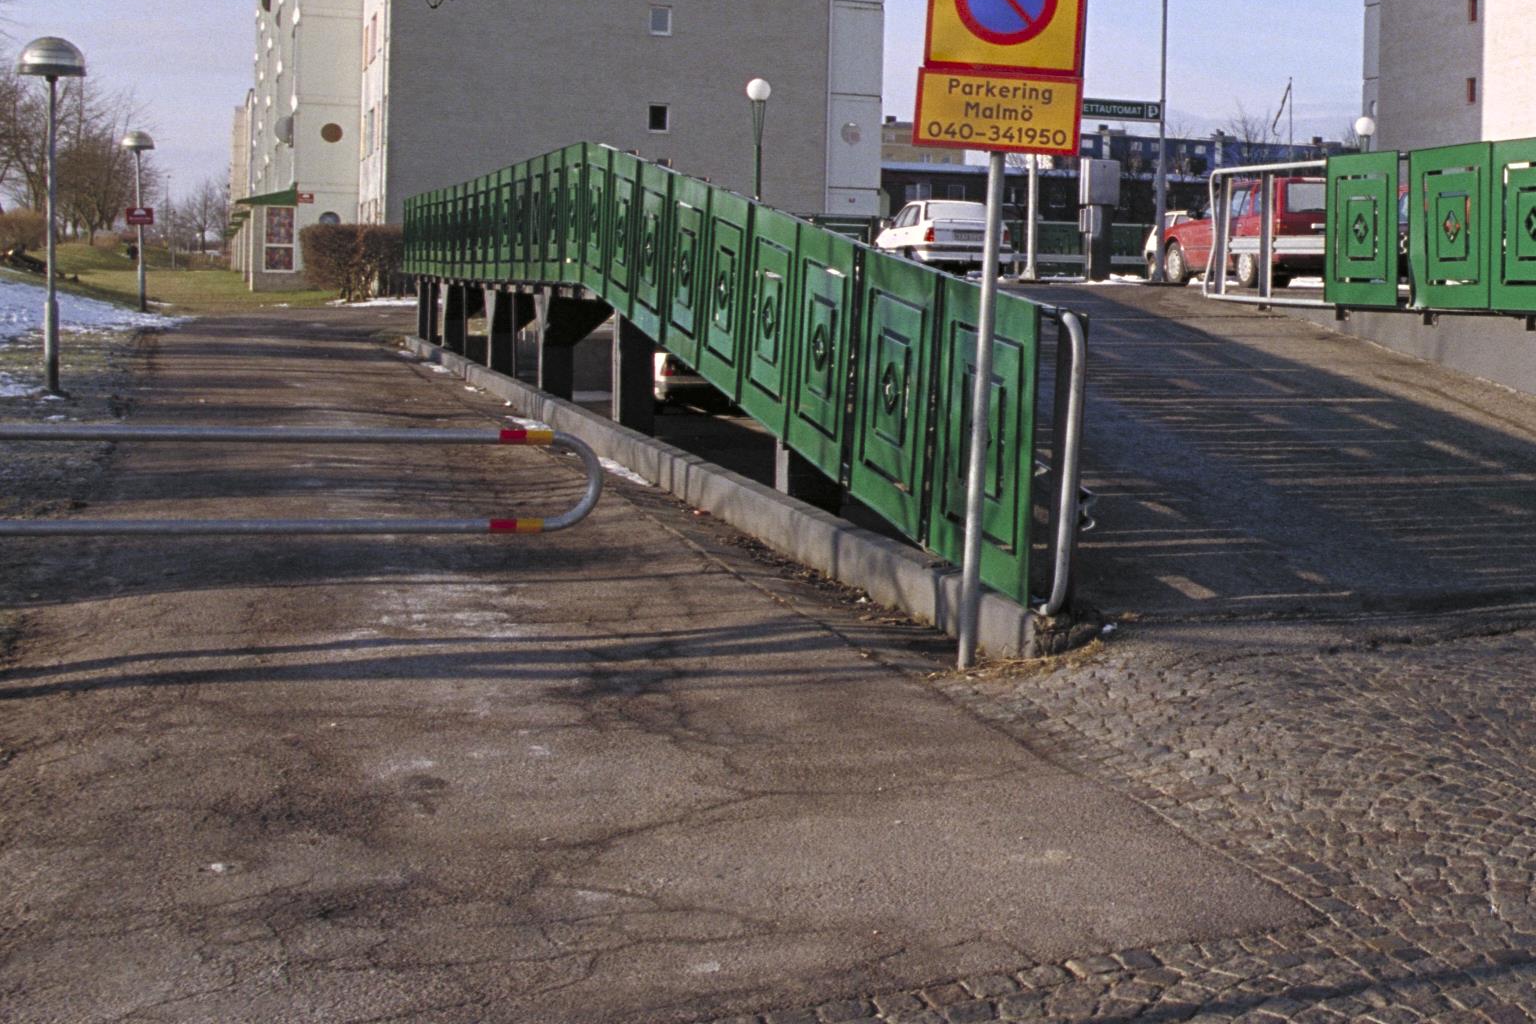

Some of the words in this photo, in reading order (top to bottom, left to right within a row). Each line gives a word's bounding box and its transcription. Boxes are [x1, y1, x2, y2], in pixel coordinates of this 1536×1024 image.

[947, 77, 1054, 105] Parkering
[963, 101, 1034, 122] Malmö
[1083, 104, 1142, 115] ETTAUTOMAT
[927, 121, 1068, 146] 040-341950
